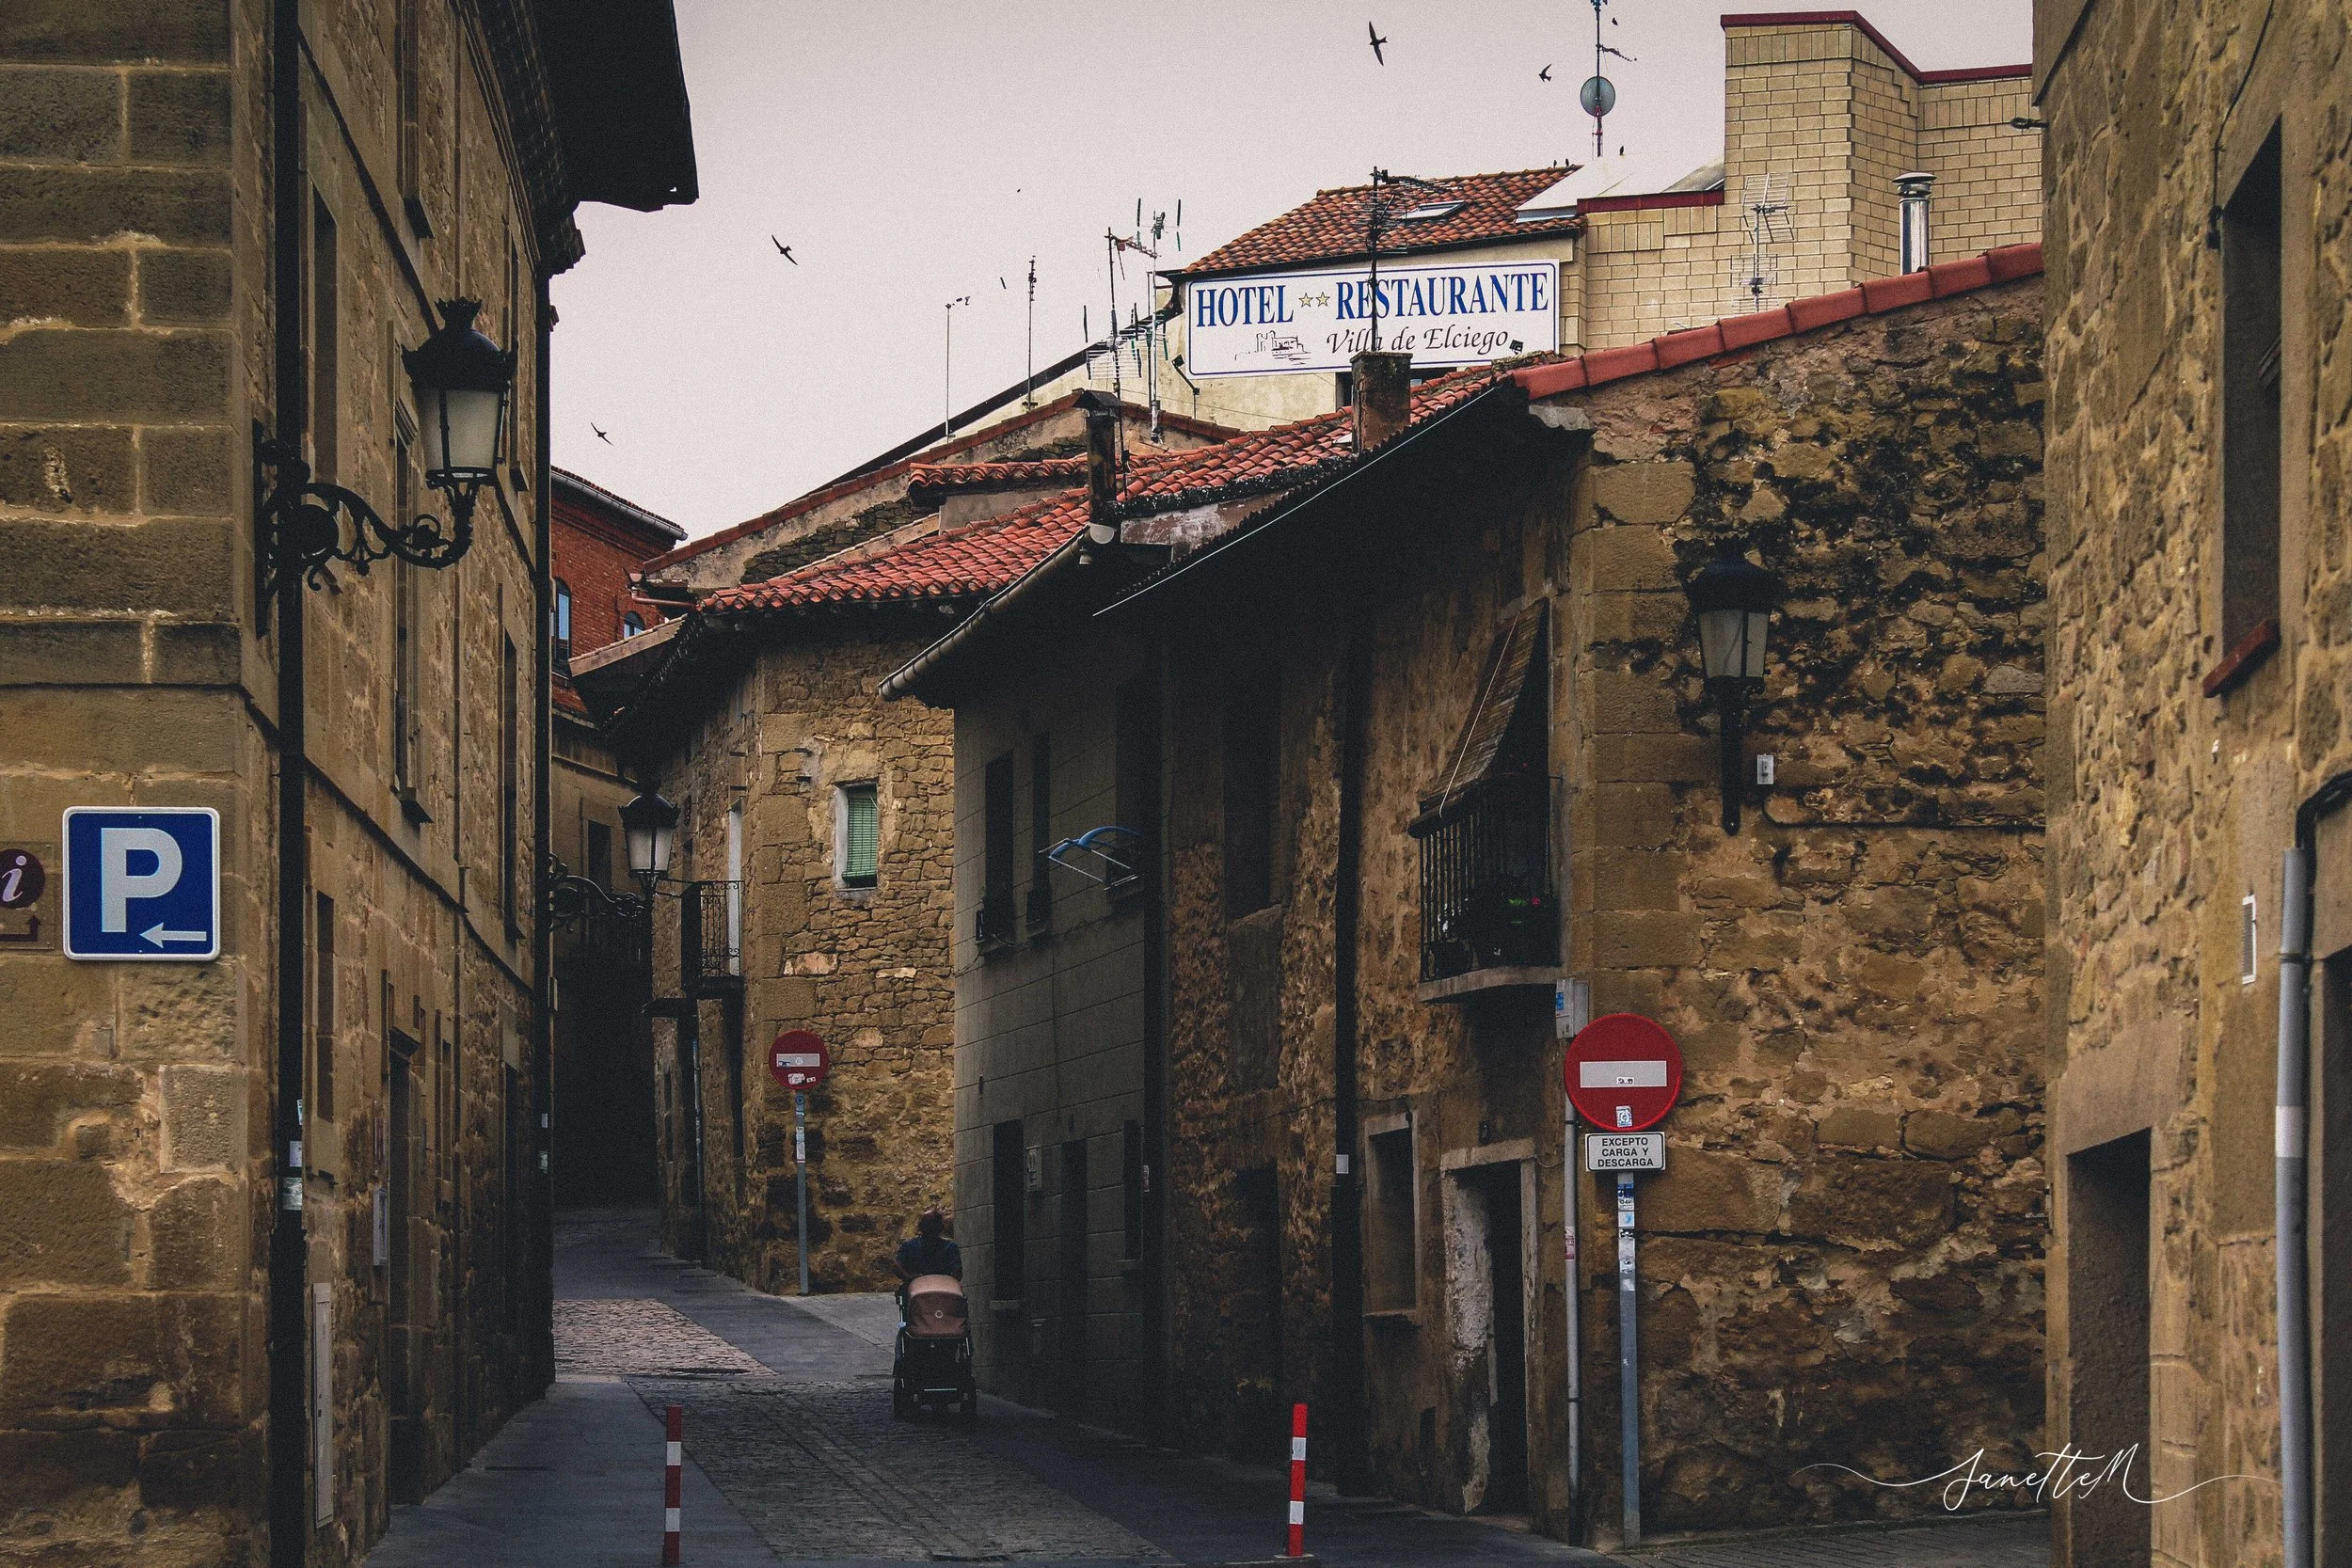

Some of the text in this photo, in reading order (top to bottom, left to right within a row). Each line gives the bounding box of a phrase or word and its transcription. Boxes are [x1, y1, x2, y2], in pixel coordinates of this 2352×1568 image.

[1196, 272, 1549, 327] HOTEL RESTAURANTE
[1391, 325, 1416, 351] de
[1423, 324, 1509, 356] Elciego
[101, 828, 183, 933] P
[1601, 1137, 1648, 1147] EXCEPTO
[1601, 1147, 1649, 1157] CARGA Y
[1597, 1157, 1654, 1167] DESCARGA
